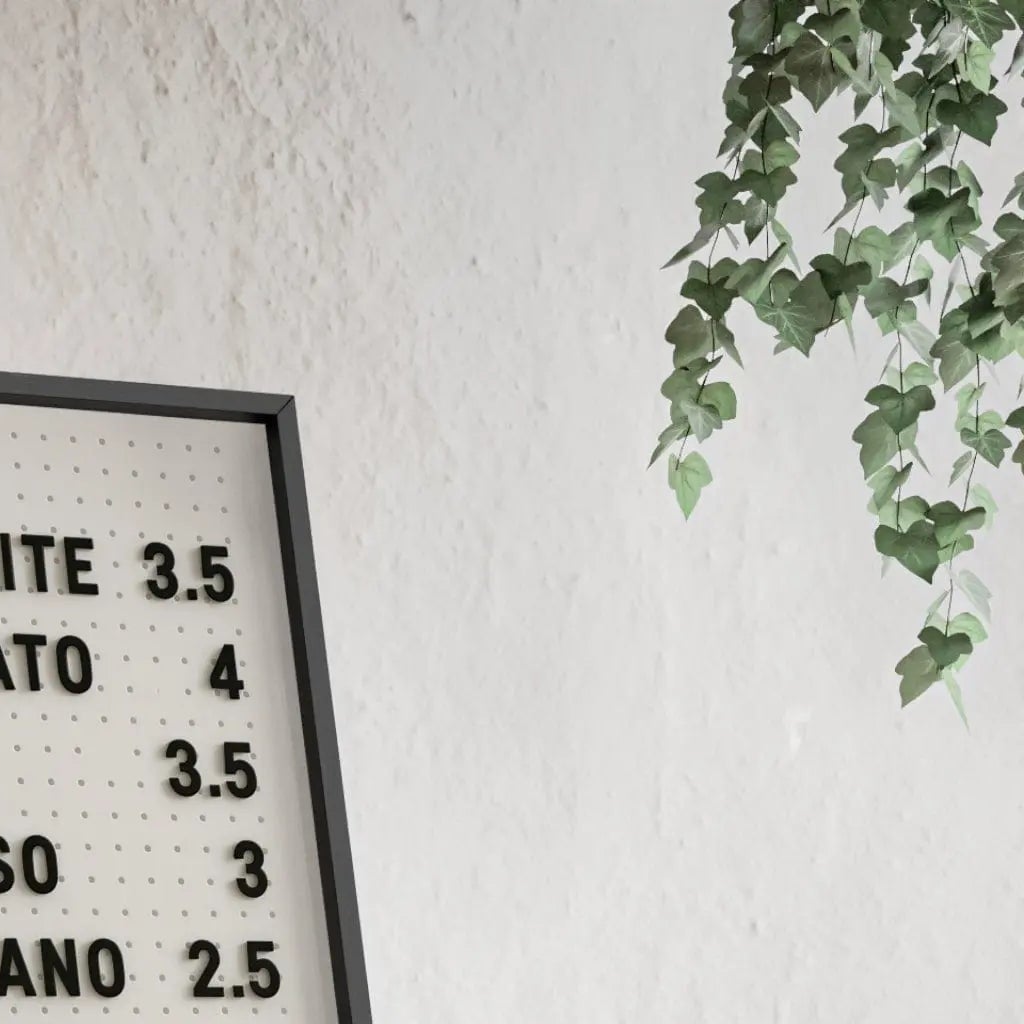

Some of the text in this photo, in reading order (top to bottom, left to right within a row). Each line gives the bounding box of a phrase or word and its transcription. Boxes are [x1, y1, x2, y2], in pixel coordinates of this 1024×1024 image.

[143, 542, 234, 603] 3.5
[209, 644, 245, 700] 4
[165, 739, 257, 799] 3.5
[232, 840, 268, 899] 3
[188, 939, 281, 999] 2.5
